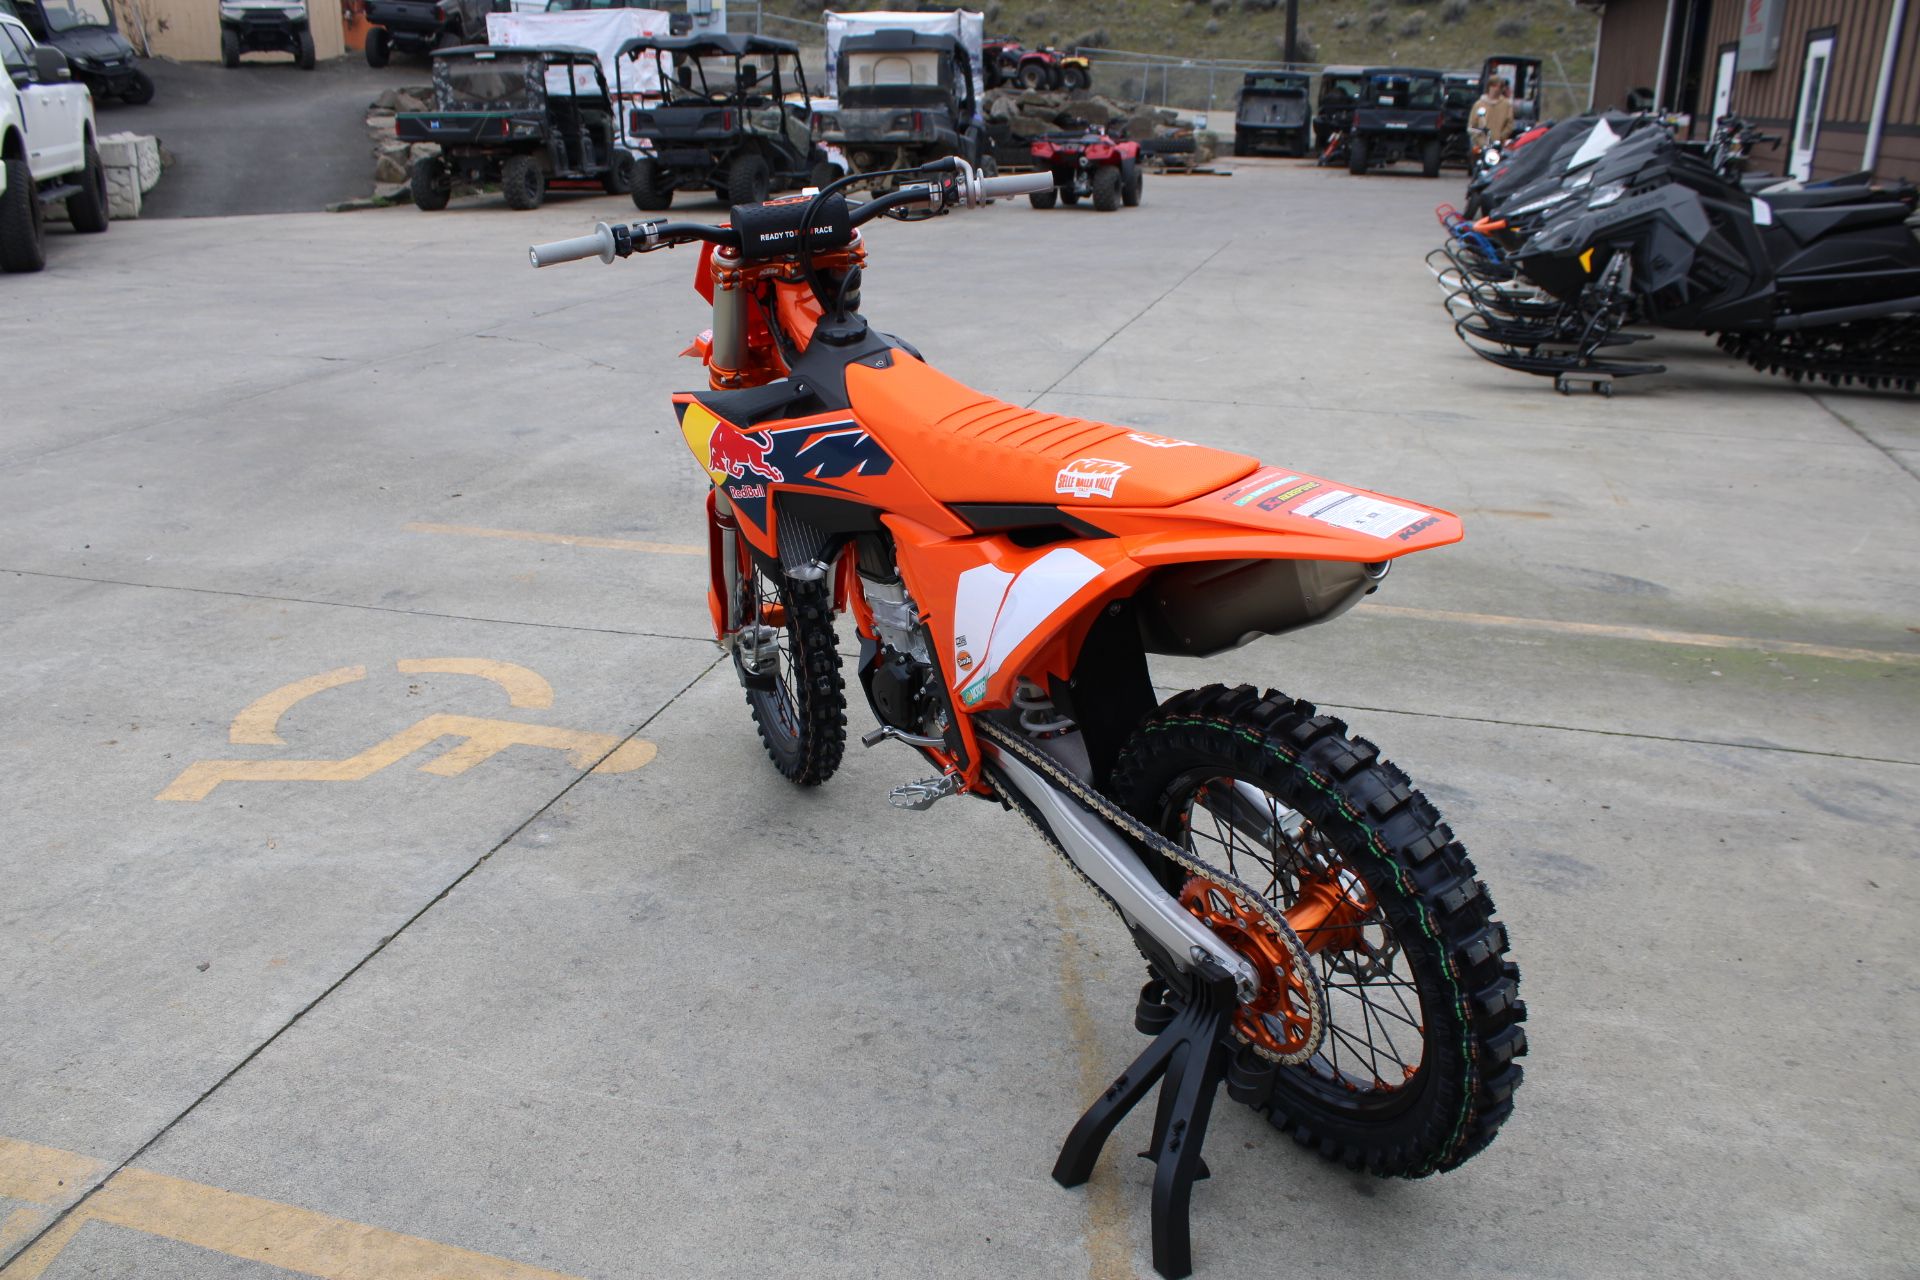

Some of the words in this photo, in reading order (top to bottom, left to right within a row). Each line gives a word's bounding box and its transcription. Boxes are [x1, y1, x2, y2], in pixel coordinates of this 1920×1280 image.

[760, 232, 784, 241] READY
[785, 230, 795, 238] TO
[814, 225, 833, 235] RACE
[1057, 473, 1075, 489] SELLE
[1094, 476, 1115, 492] VALLE
[1397, 516, 1440, 541] KTM
